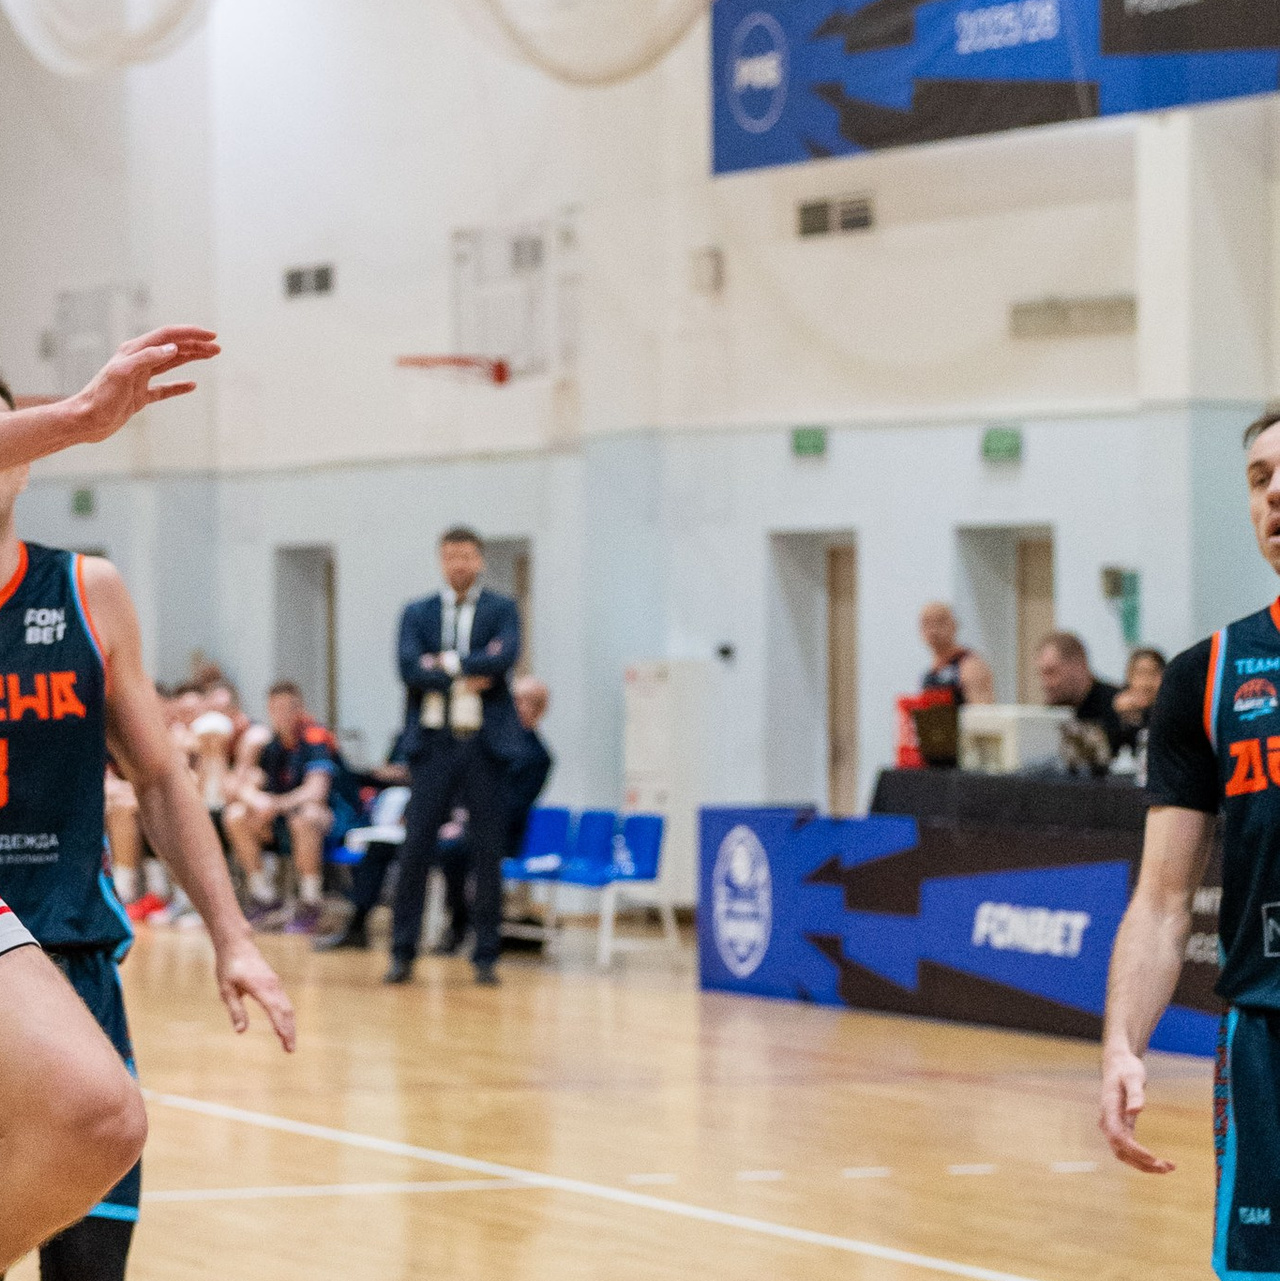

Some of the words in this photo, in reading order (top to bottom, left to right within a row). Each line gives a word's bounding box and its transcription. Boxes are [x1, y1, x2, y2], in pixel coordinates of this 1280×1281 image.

[23, 607, 66, 626] FON
[24, 622, 67, 645] BET
[971, 901, 1091, 958] FONBET
